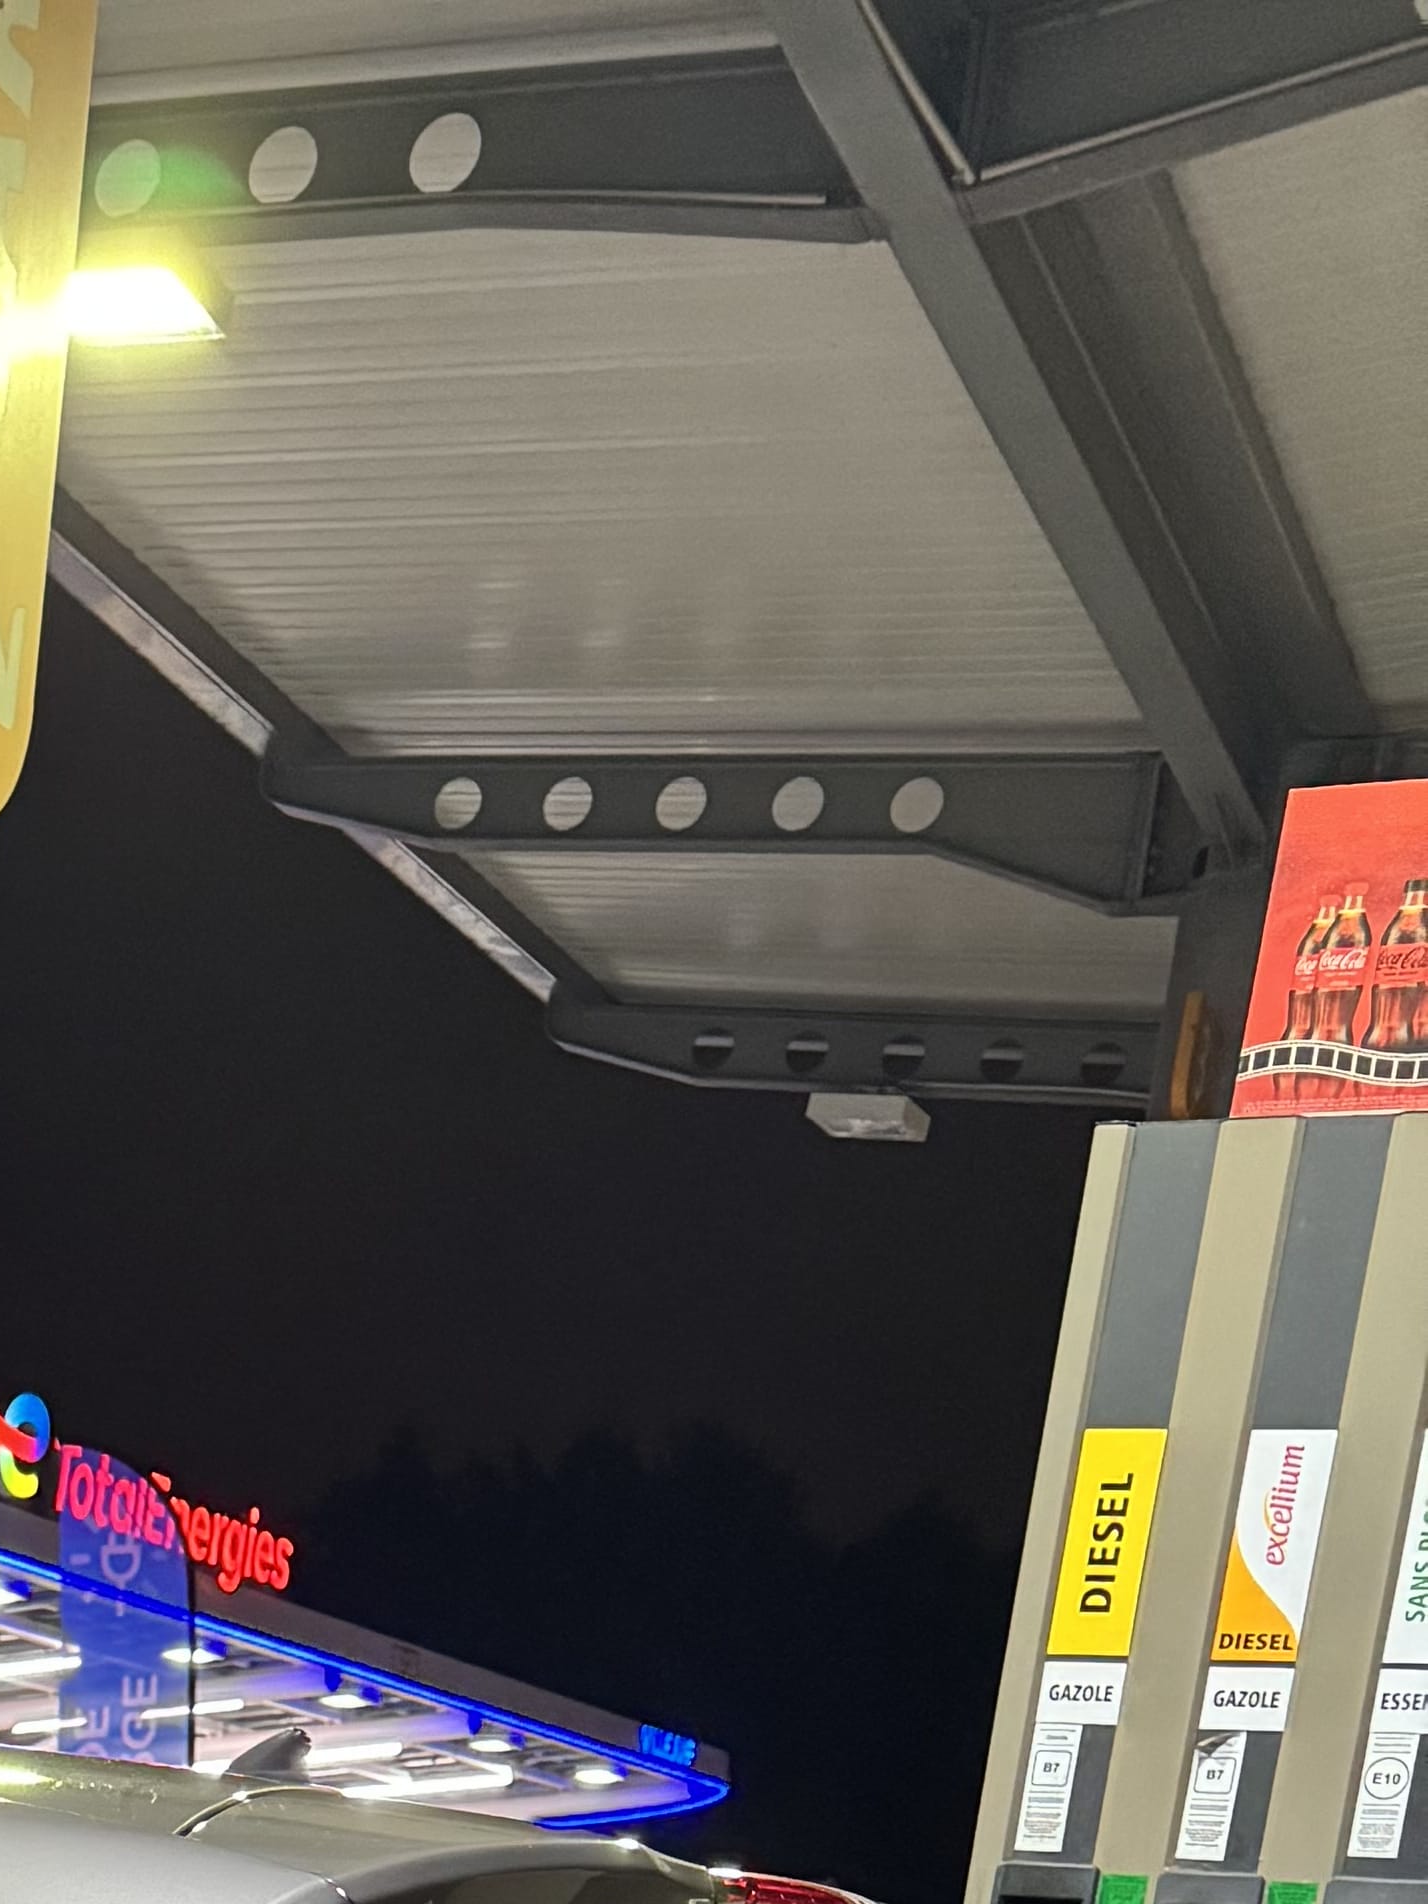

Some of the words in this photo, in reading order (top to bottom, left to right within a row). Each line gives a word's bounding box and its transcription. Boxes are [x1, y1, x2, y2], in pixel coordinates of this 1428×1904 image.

[1266, 1444, 1305, 1566] excellium
[1080, 1473, 1134, 1613] DIESEL
[1218, 1633, 1294, 1651] DIESEL
[1049, 1684, 1114, 1702] GAZOLE
[1213, 1690, 1281, 1709] GAZOLE
[1043, 1762, 1061, 1773] B7
[1206, 1769, 1224, 1780] B7
[1372, 1772, 1401, 1785] E10
